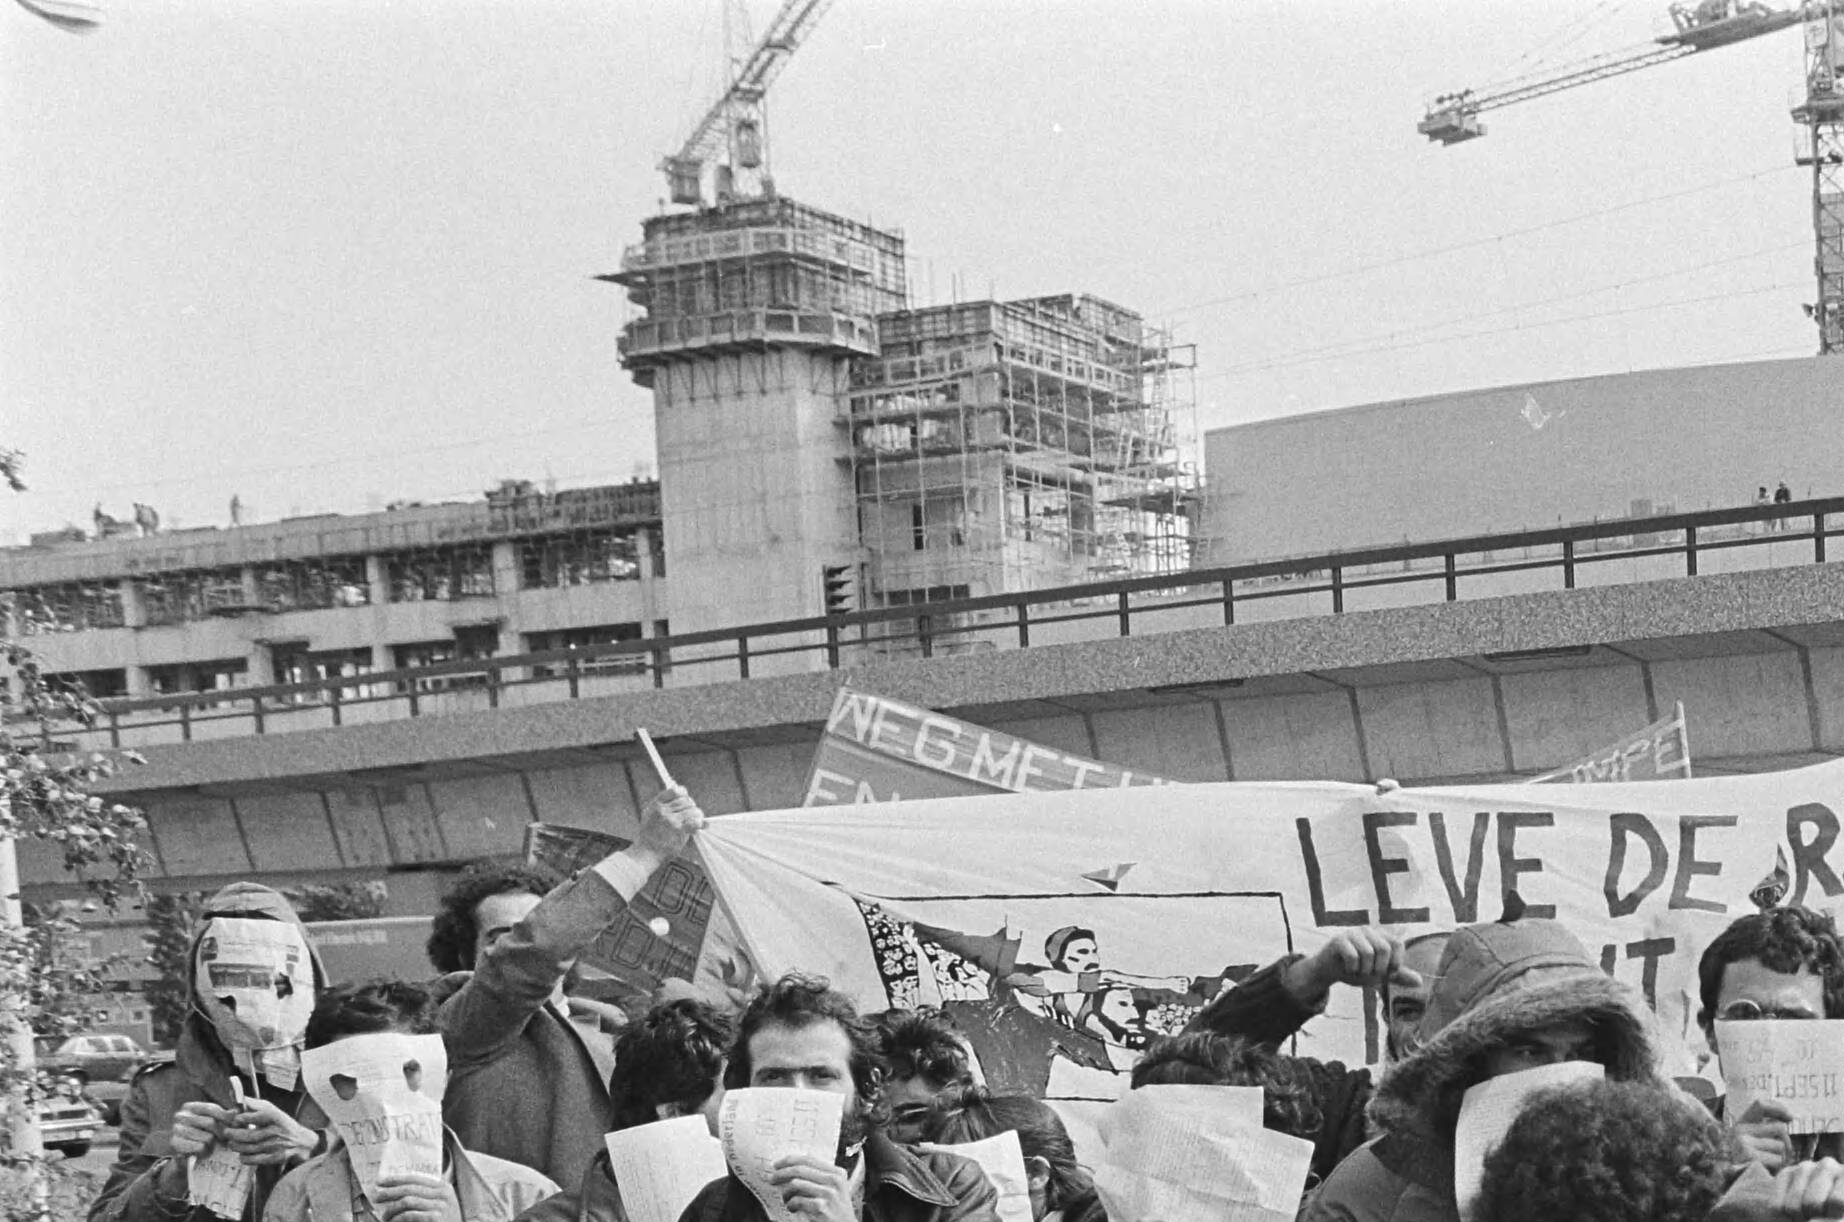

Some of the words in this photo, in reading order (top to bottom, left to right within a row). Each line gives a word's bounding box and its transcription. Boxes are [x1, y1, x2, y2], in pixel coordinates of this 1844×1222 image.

[827, 692, 962, 770] WEG
[1296, 811, 1557, 928] LEVE
[1604, 812, 1738, 917] DE
